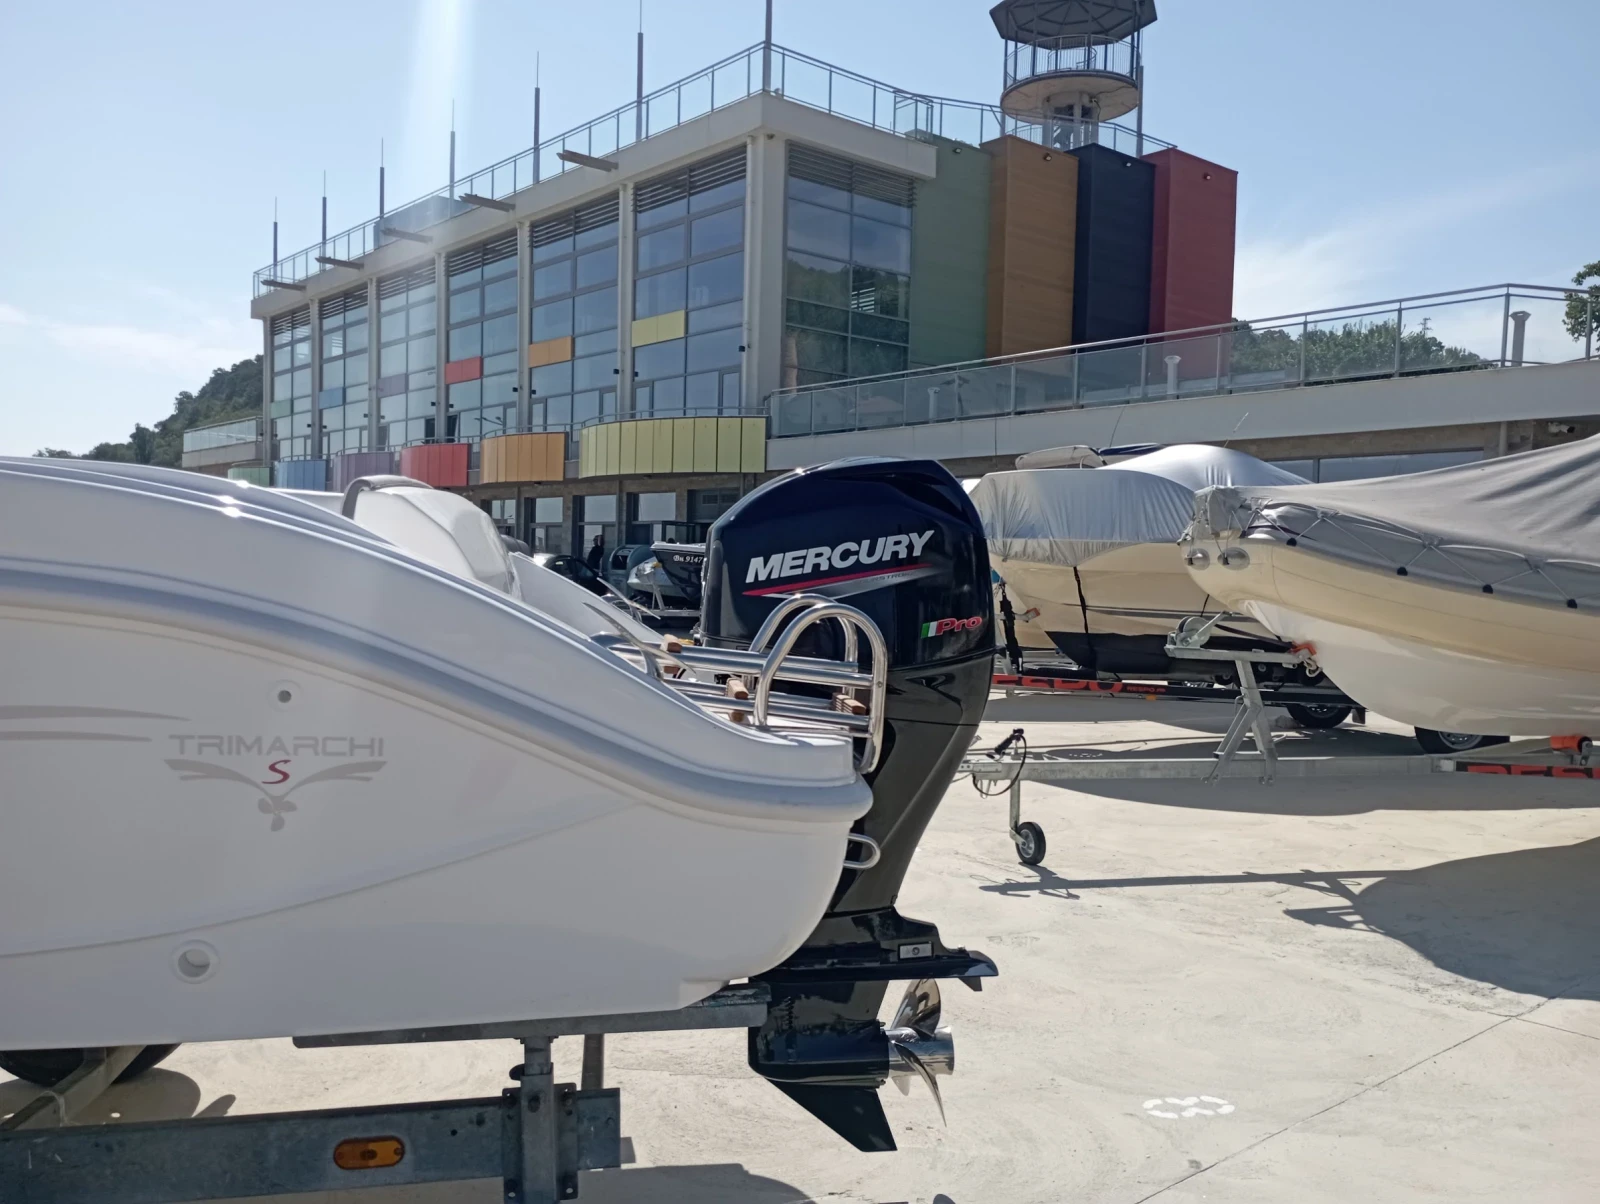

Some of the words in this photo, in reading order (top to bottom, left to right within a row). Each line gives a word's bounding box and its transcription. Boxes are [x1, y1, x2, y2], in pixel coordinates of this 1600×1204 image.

[745, 530, 935, 583] MERCURY
[936, 616, 983, 635] Pro
[168, 734, 384, 757] TRIMARCHI
[261, 759, 292, 785] S
